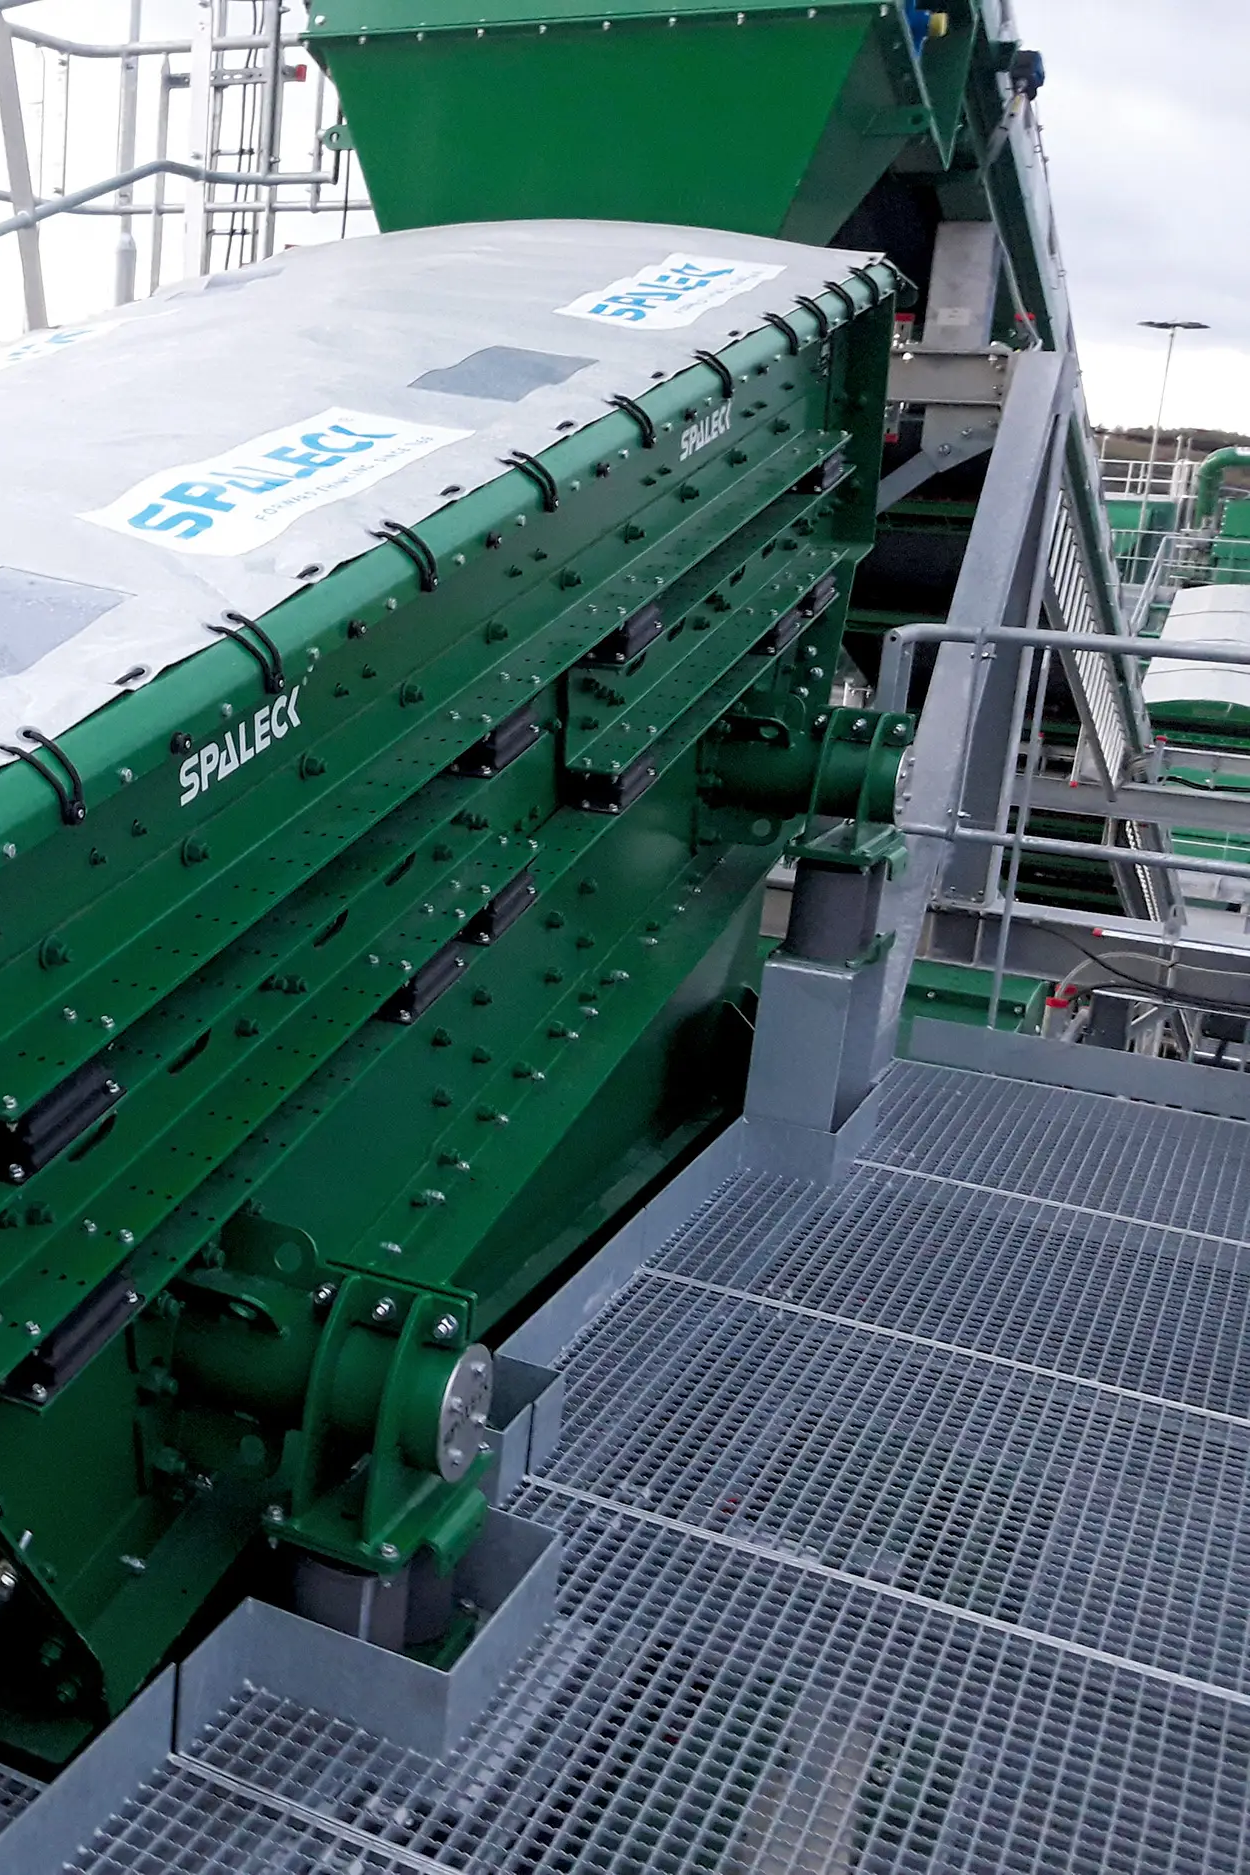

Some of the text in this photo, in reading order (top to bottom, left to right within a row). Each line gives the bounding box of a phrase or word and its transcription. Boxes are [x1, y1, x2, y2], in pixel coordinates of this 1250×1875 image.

[127, 425, 398, 541] SPALECK
[679, 398, 731, 461] SPALECK
[179, 685, 301, 807] SPALECK
